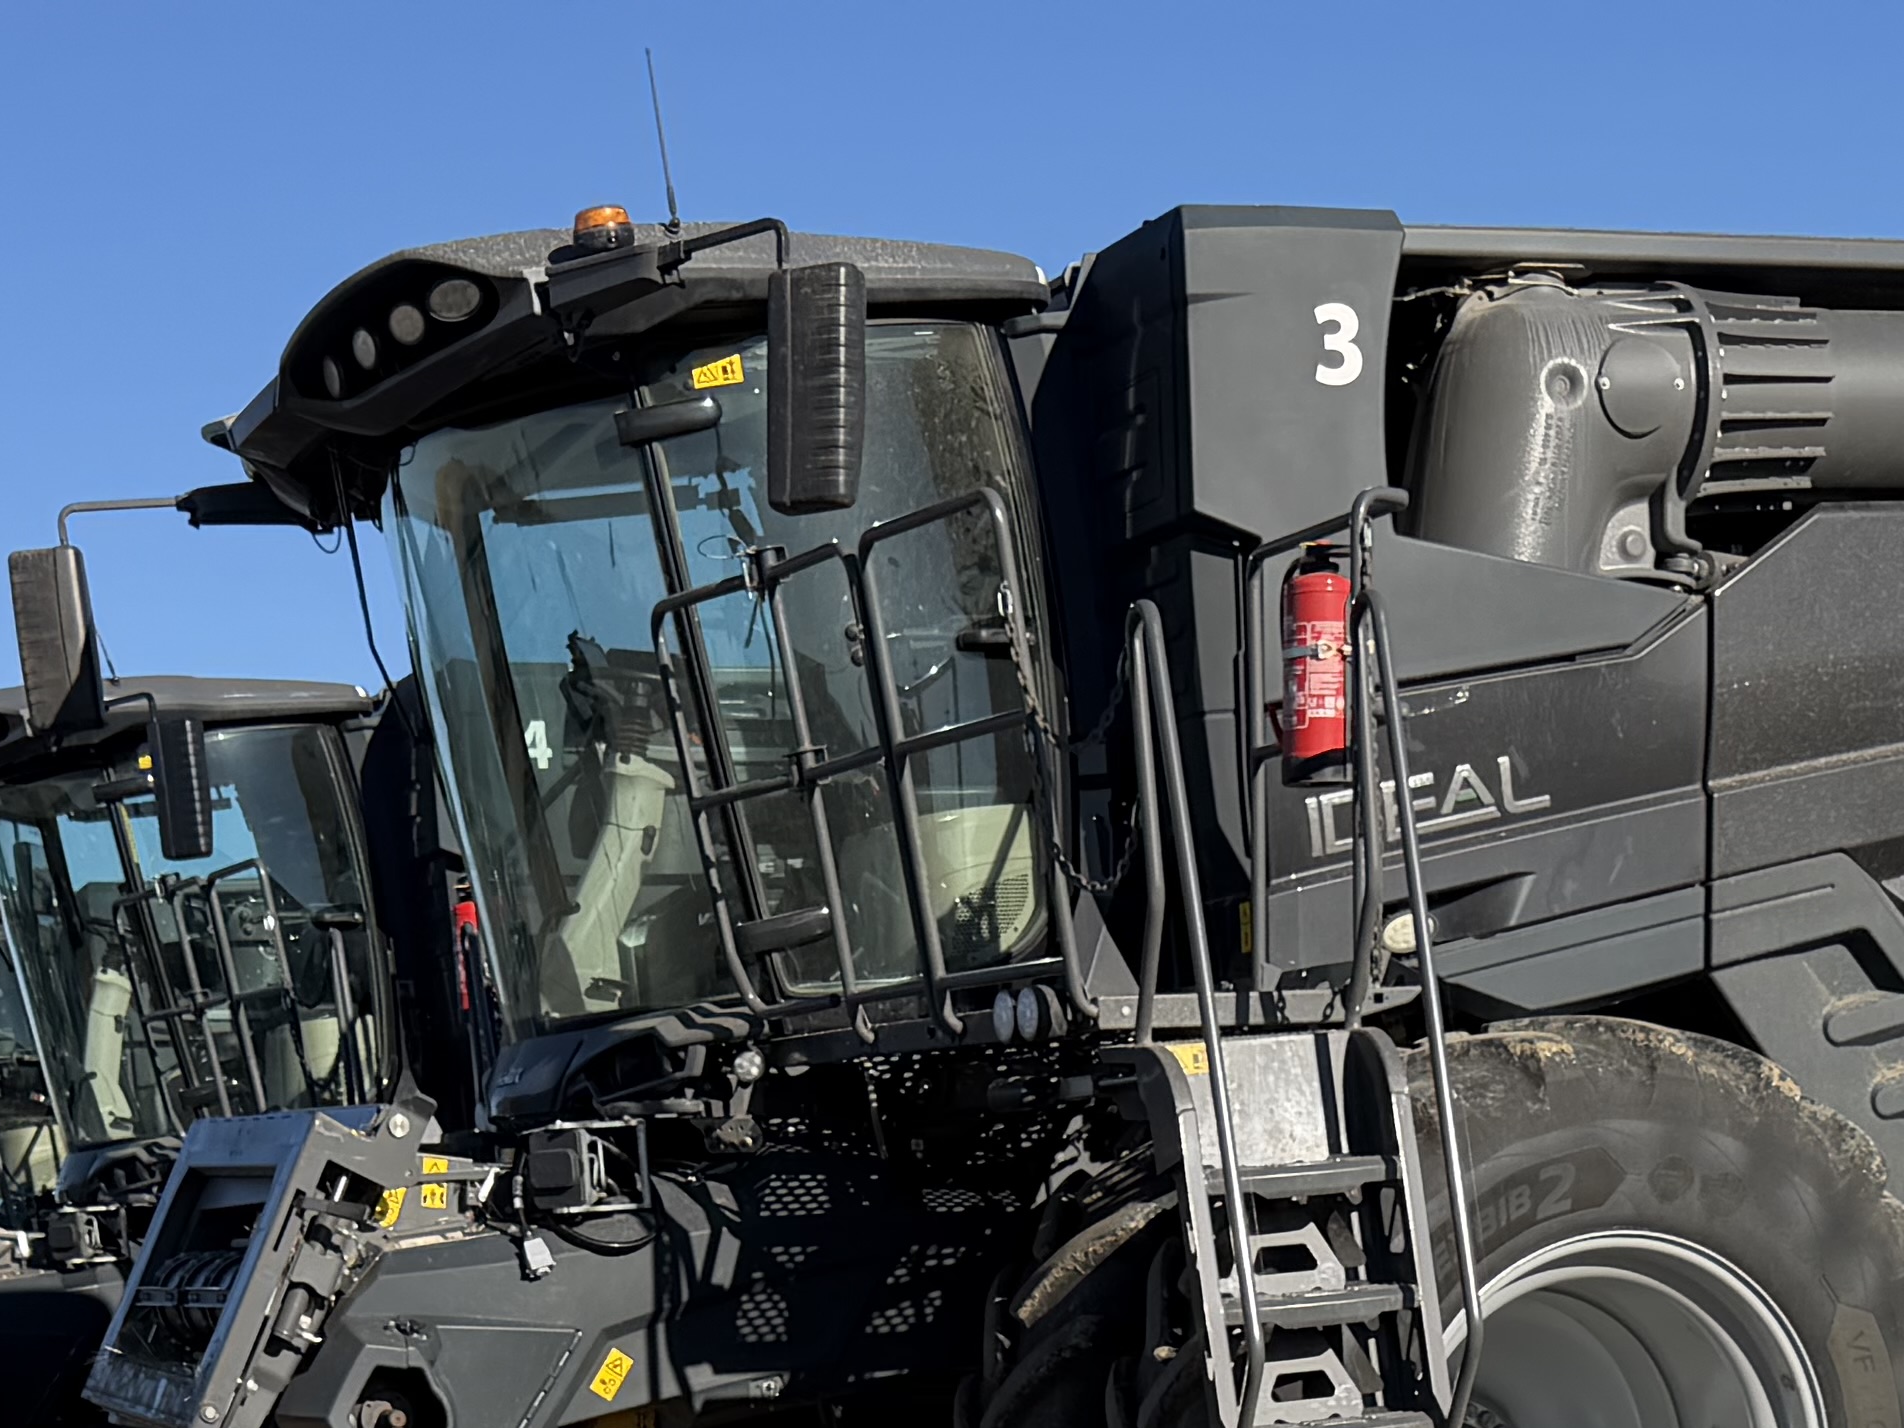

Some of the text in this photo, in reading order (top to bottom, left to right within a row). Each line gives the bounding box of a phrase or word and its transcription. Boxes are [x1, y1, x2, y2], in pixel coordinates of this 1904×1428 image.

[1313, 302, 1364, 386] 3
[524, 720, 553, 769] 4
[1304, 755, 1552, 858] IDEAL
[1536, 1162, 1577, 1221] 2
